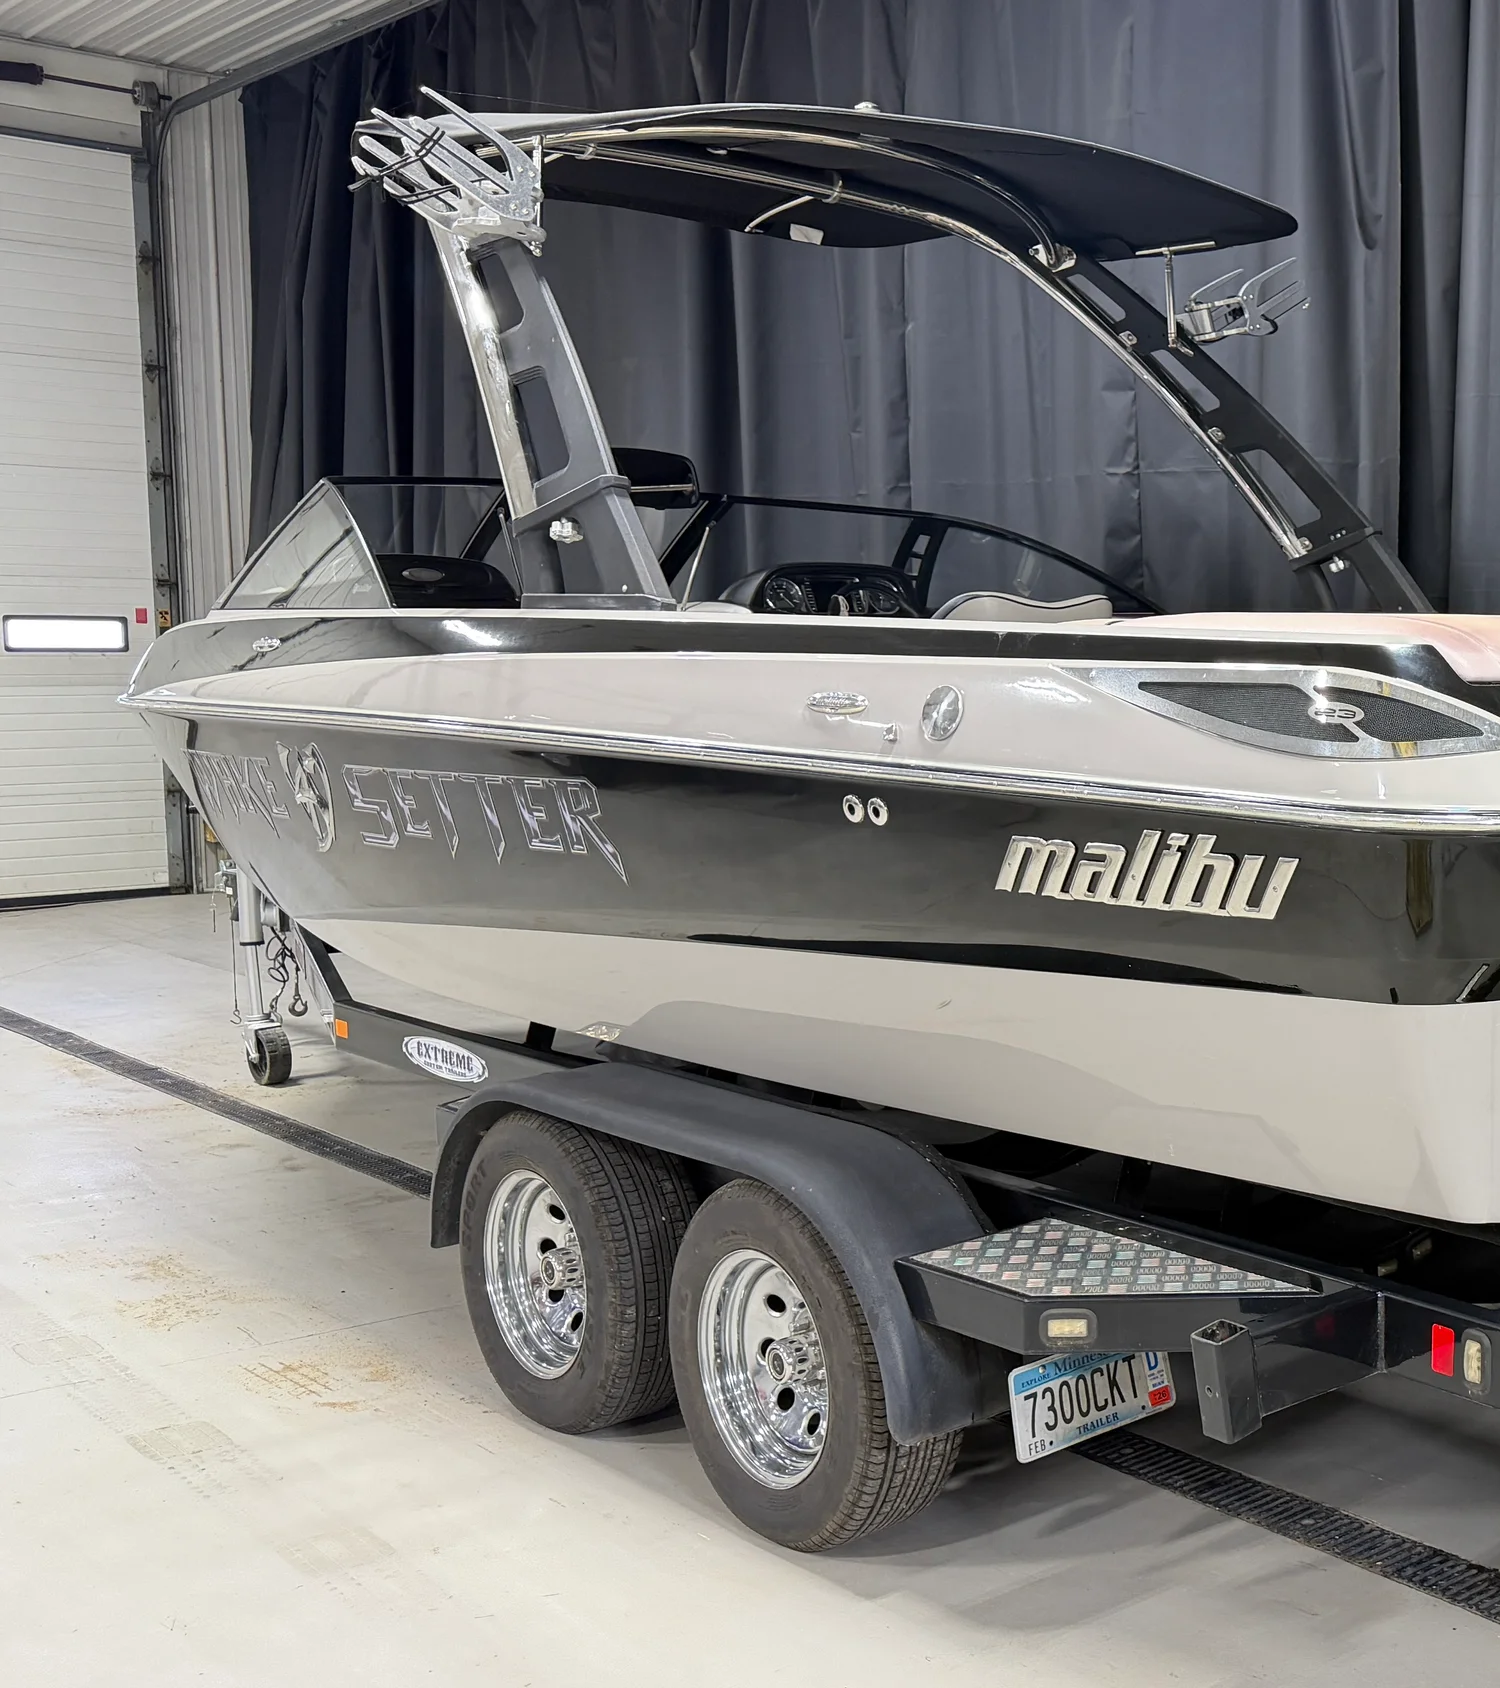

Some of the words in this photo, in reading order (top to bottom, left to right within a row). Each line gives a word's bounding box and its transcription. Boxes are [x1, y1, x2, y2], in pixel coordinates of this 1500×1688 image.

[1314, 706, 1357, 719] 23
[341, 764, 630, 887] SETTER
[994, 829, 1300, 920] malibu
[416, 1040, 475, 1074] EXTREME
[1023, 1353, 1139, 1439] 7300CKT
[1075, 1411, 1121, 1436] TRAILER
[1028, 1438, 1047, 1456] FEB
